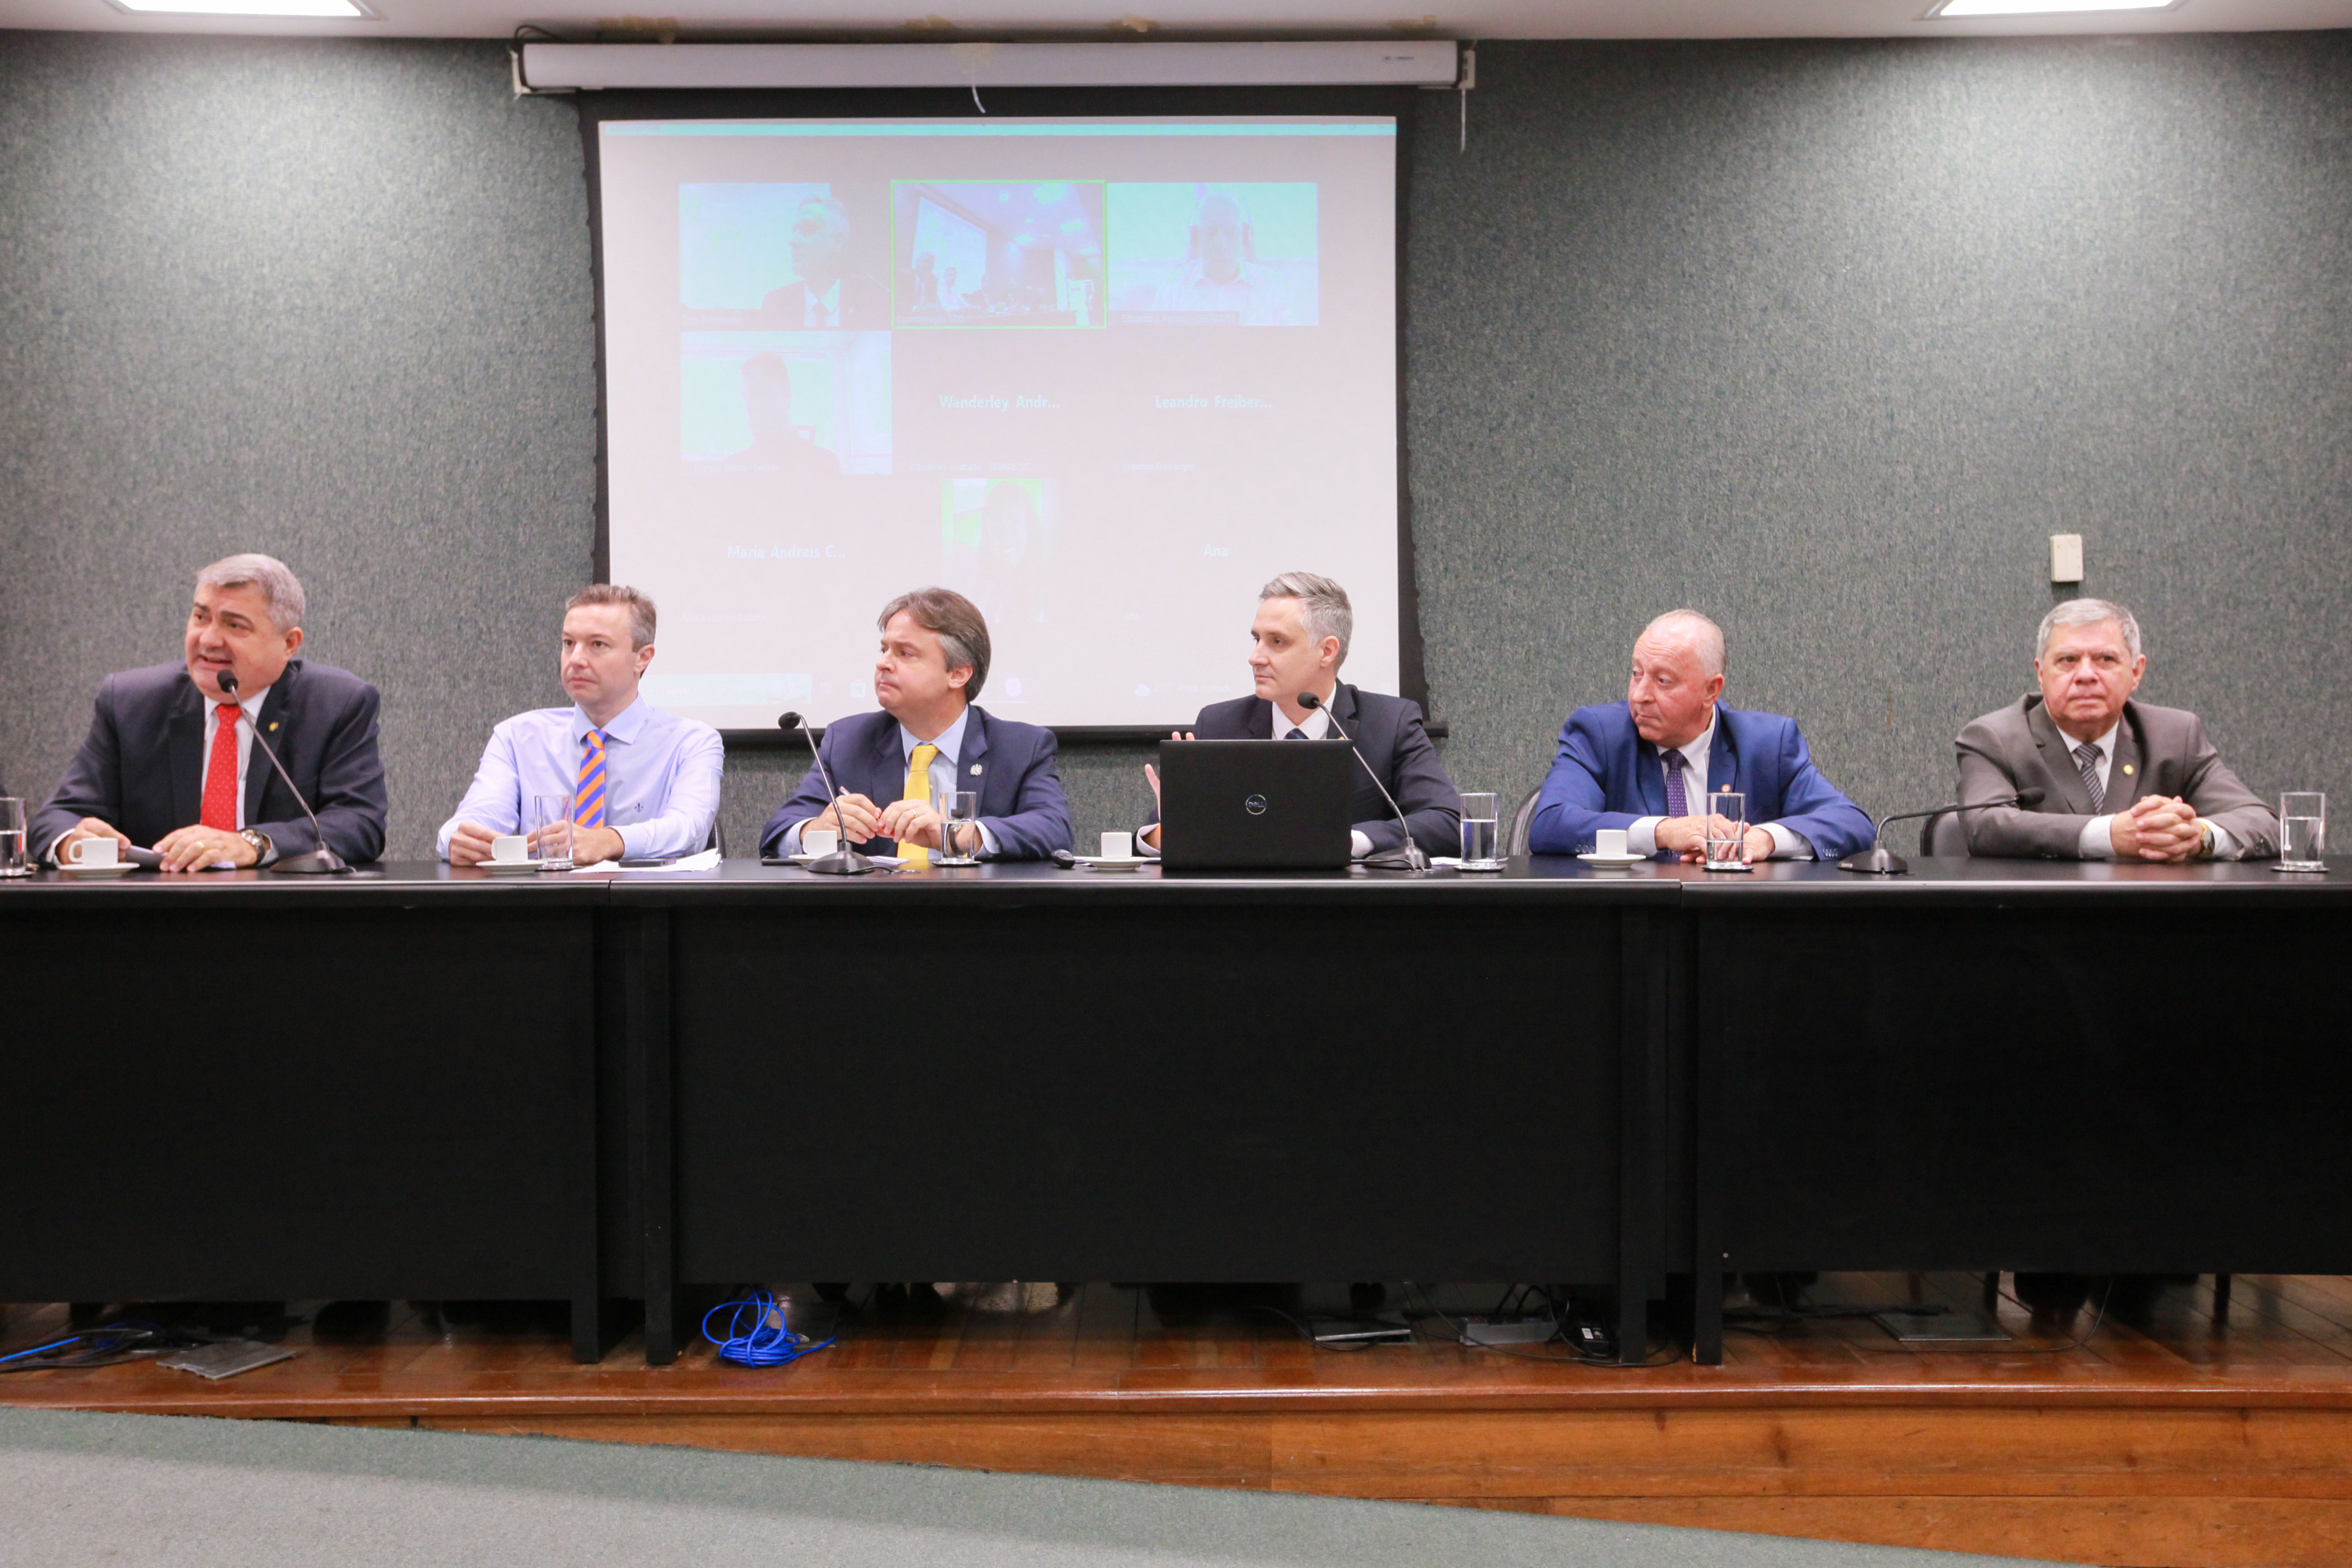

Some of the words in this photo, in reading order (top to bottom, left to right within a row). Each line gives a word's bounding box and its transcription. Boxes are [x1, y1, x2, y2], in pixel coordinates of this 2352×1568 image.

[939, 394, 1009, 412] Wanderley
[1015, 394, 1061, 409] Andr...
[1155, 394, 1209, 408] Leandro
[1214, 394, 1273, 409] Freiber...
[727, 544, 765, 559] Maria
[770, 544, 820, 558] Andreis
[825, 544, 847, 558] C...
[1202, 544, 1229, 557] Ana
